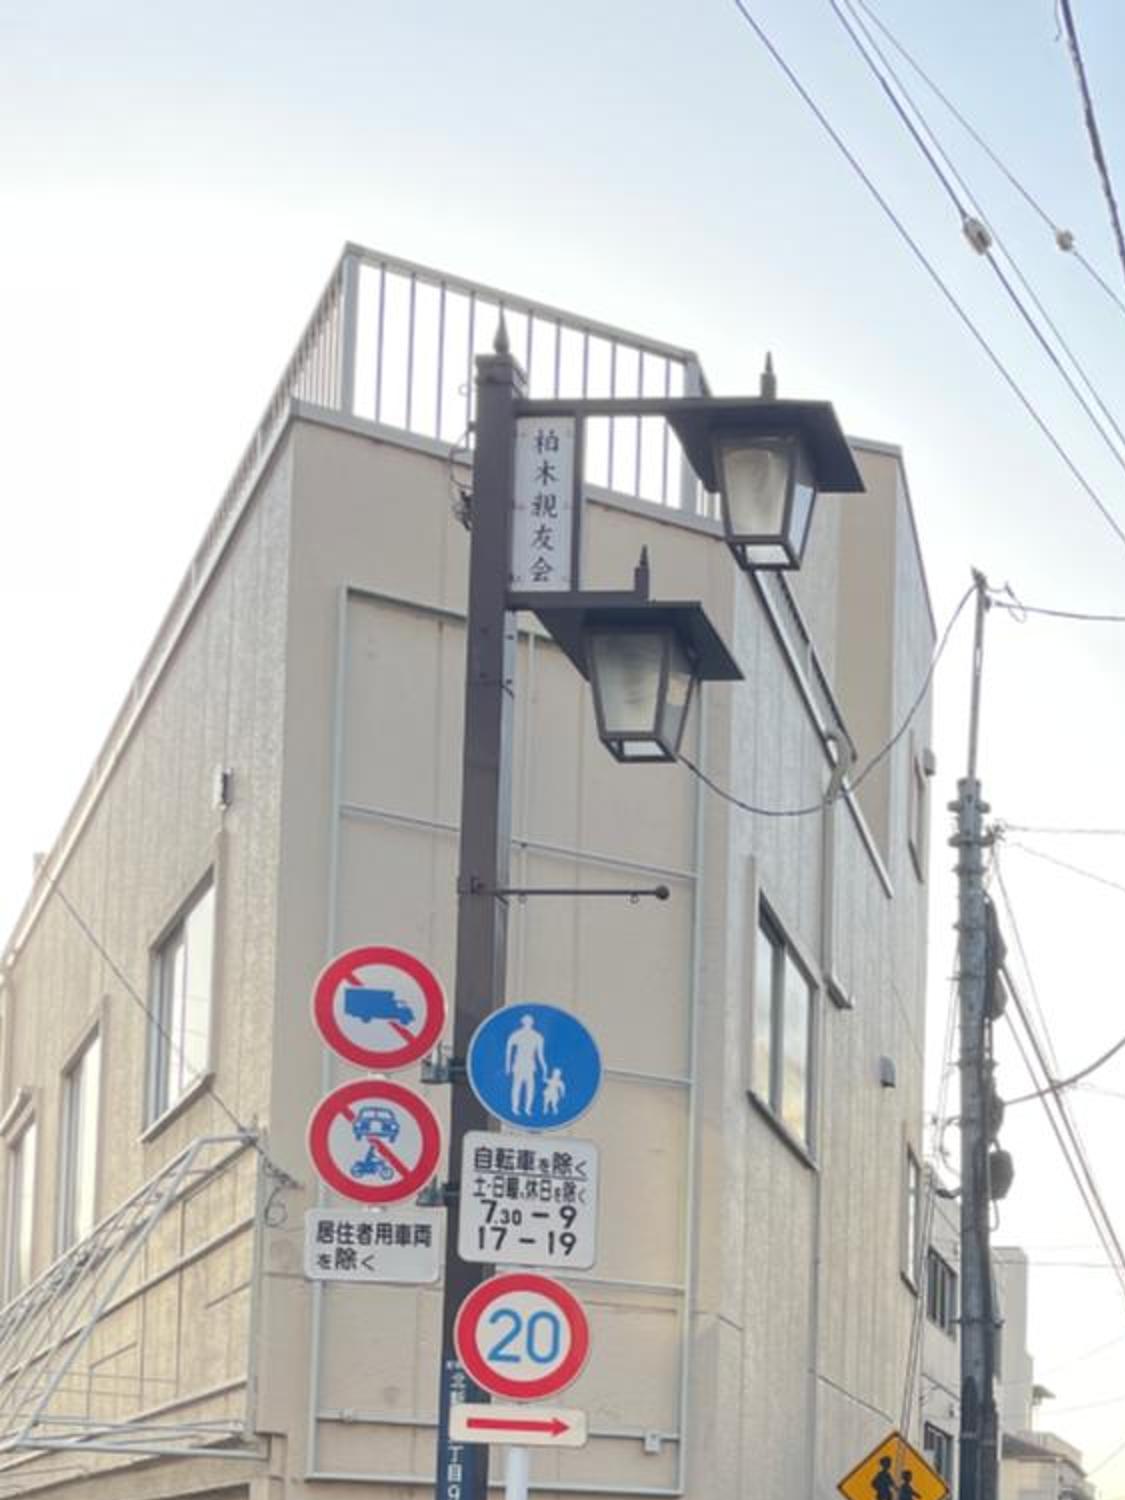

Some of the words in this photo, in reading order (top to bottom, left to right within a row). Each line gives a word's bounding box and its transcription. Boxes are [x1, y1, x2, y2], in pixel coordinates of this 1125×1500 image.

[474, 1146, 587, 1177] 自転車を除く
[316, 1220, 432, 1248] 居住者用車両
[317, 1247, 375, 1271] を除く
[487, 1308, 561, 1364] 20
